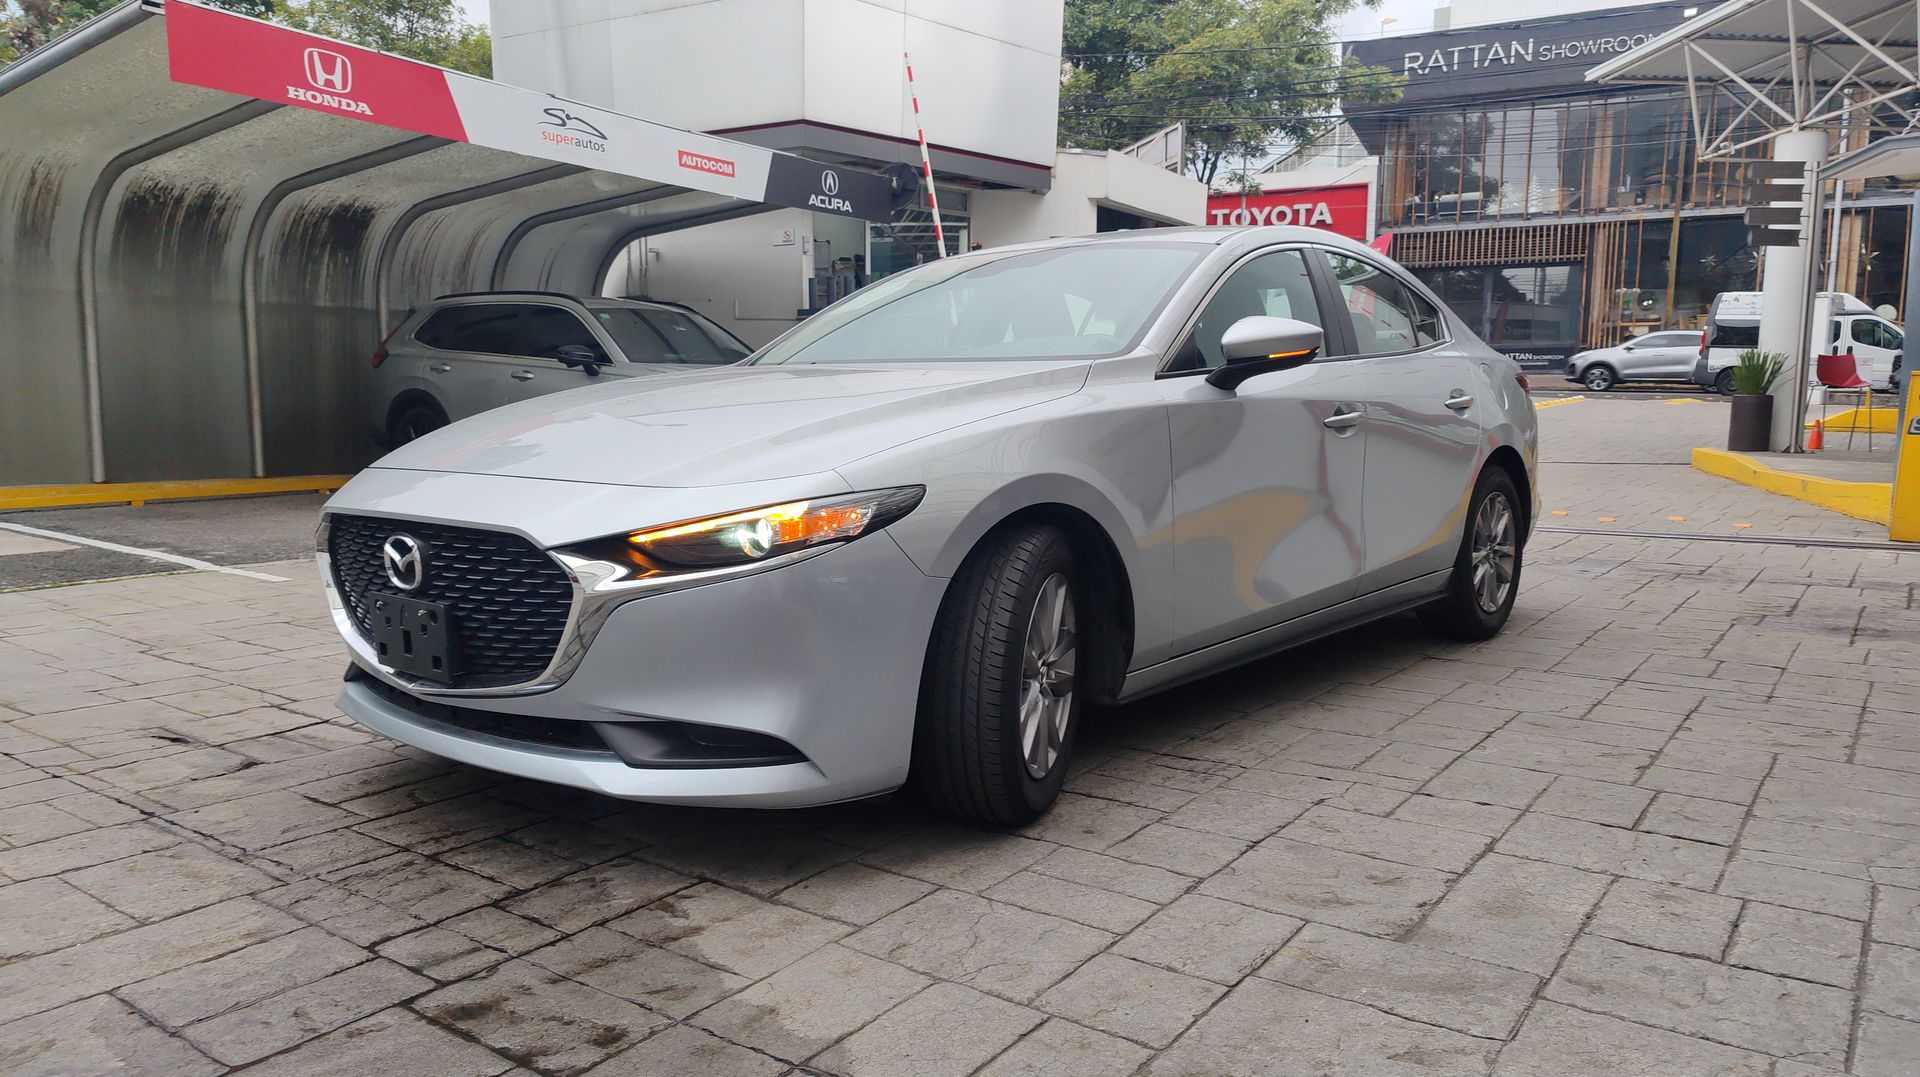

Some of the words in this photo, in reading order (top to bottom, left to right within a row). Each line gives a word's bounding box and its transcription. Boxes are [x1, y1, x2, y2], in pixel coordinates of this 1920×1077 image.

[1404, 38, 1534, 75] RATTAN
[1539, 33, 1664, 61] SHOWROO
[286, 85, 374, 116] HONDA
[542, 130, 606, 153] superautos
[681, 154, 733, 175] AUTOCOM
[808, 194, 853, 213] ACURA
[1211, 202, 1333, 226] TOYOTA
